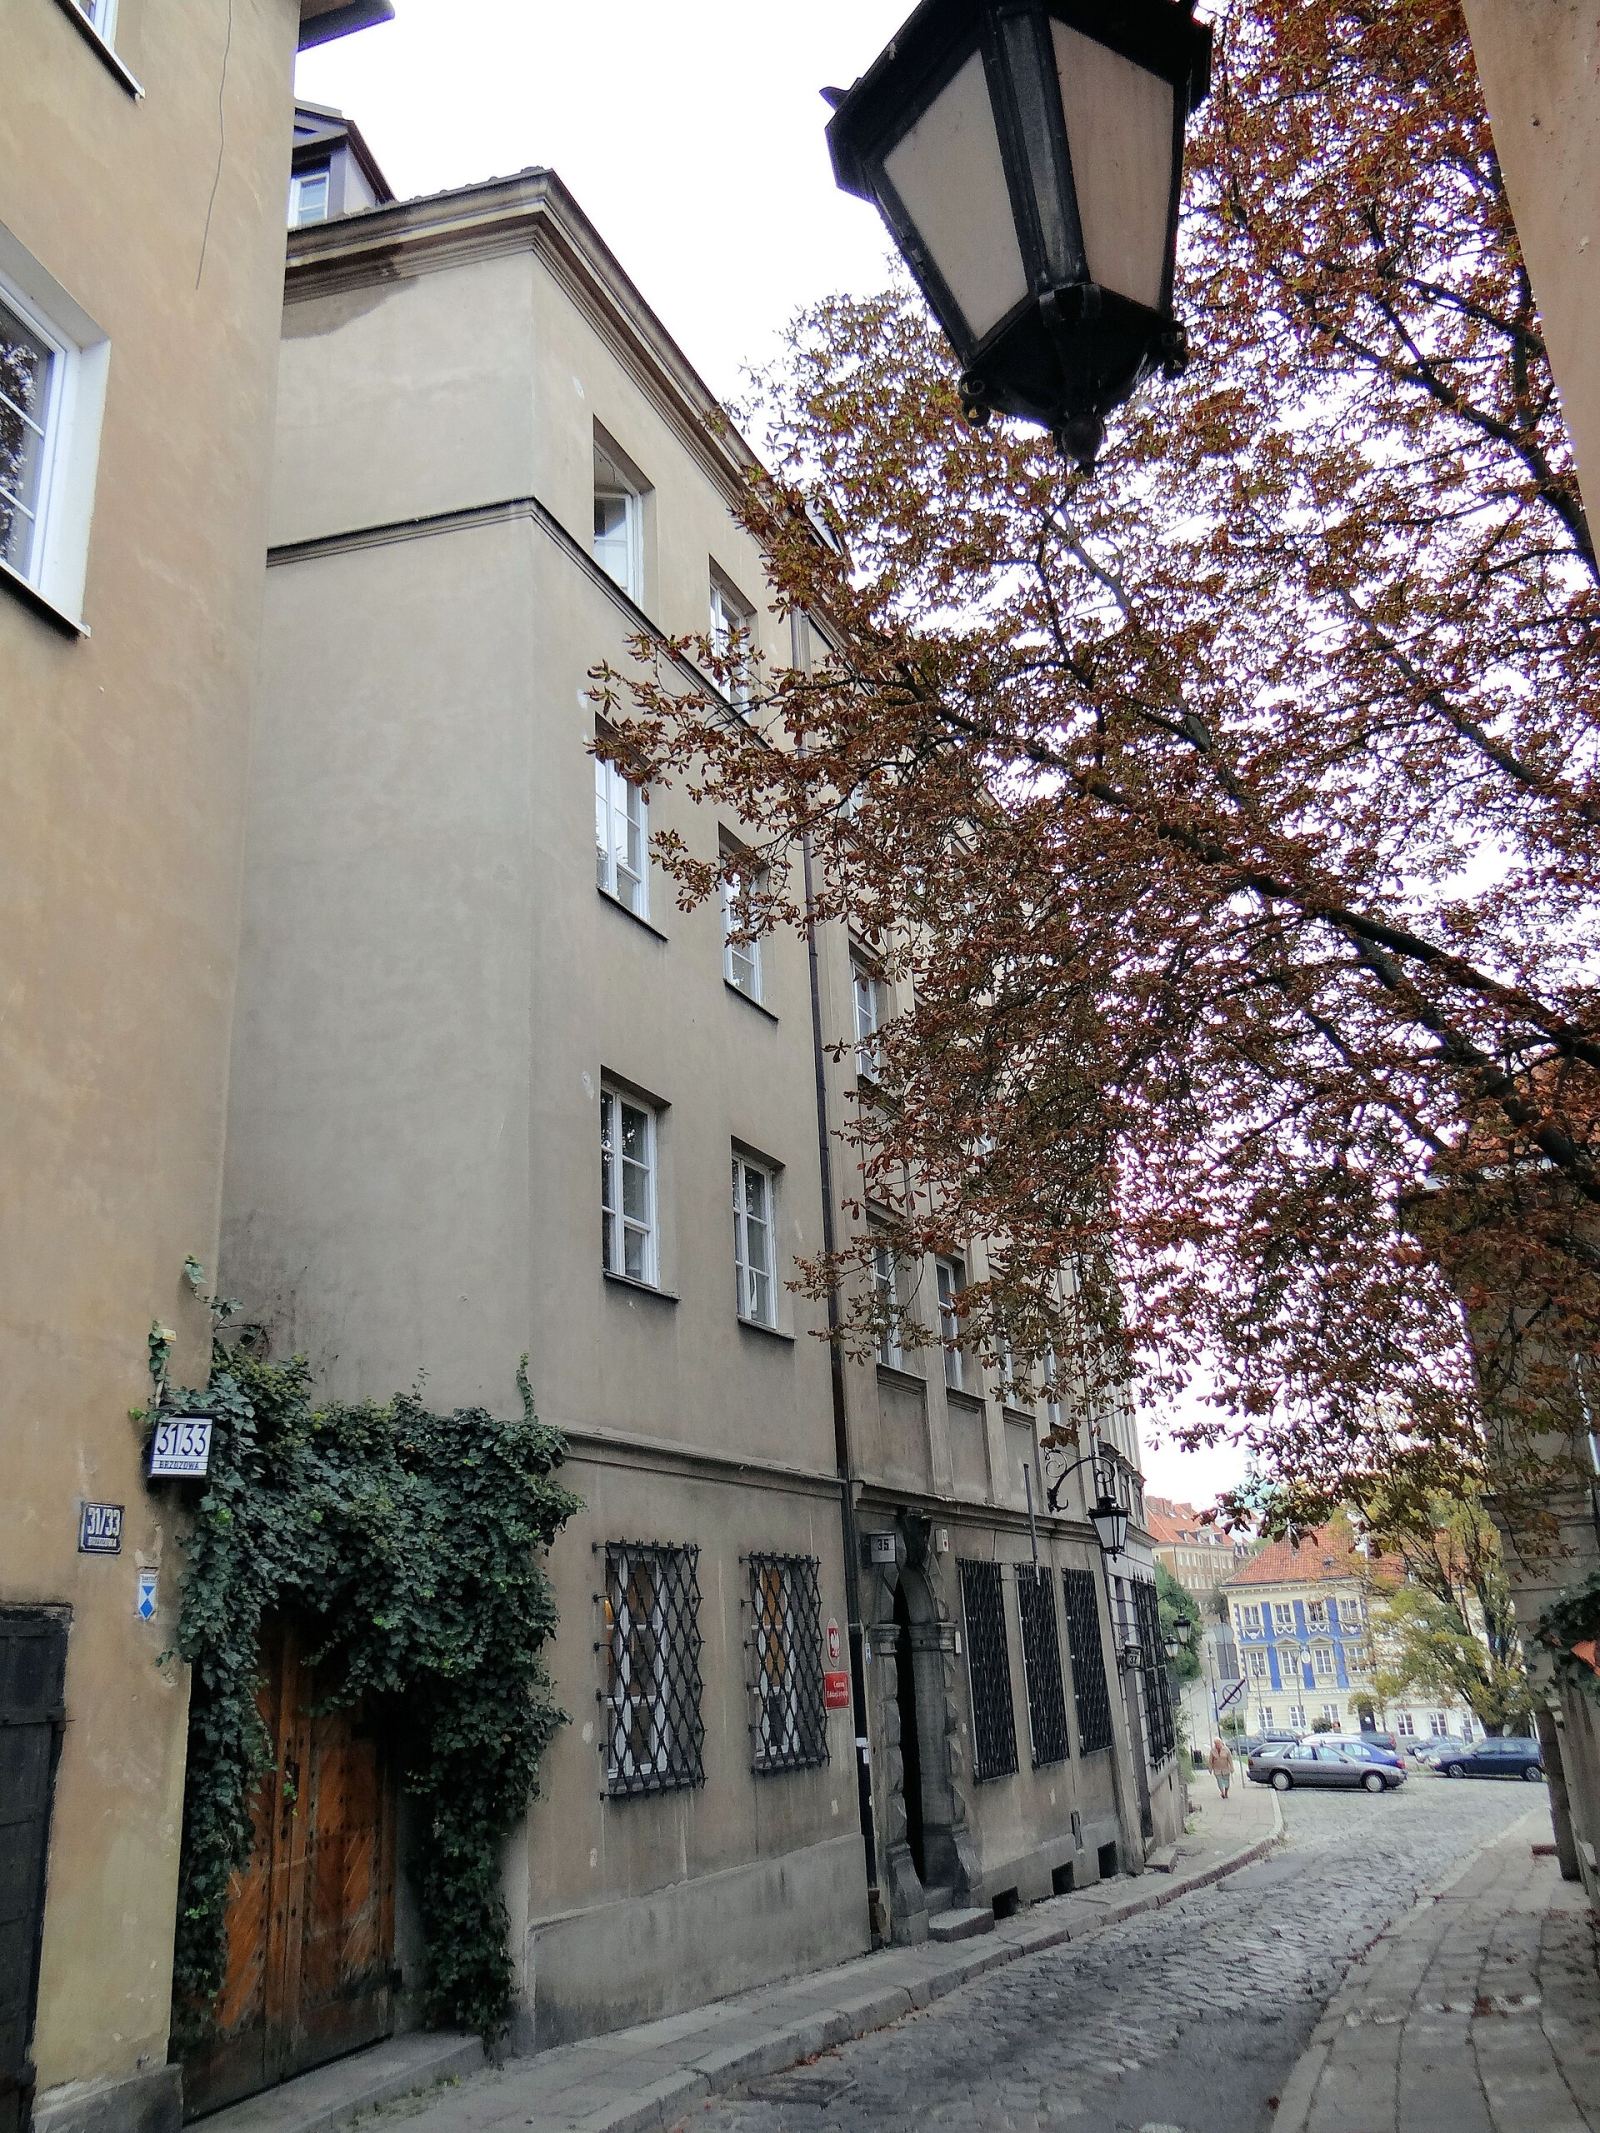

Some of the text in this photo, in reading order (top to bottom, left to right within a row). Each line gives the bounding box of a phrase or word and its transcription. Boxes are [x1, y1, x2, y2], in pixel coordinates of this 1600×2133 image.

[87, 1507, 121, 1537] 31/33
[878, 1539, 889, 1551] 35
[1129, 1655, 1138, 1665] 37
